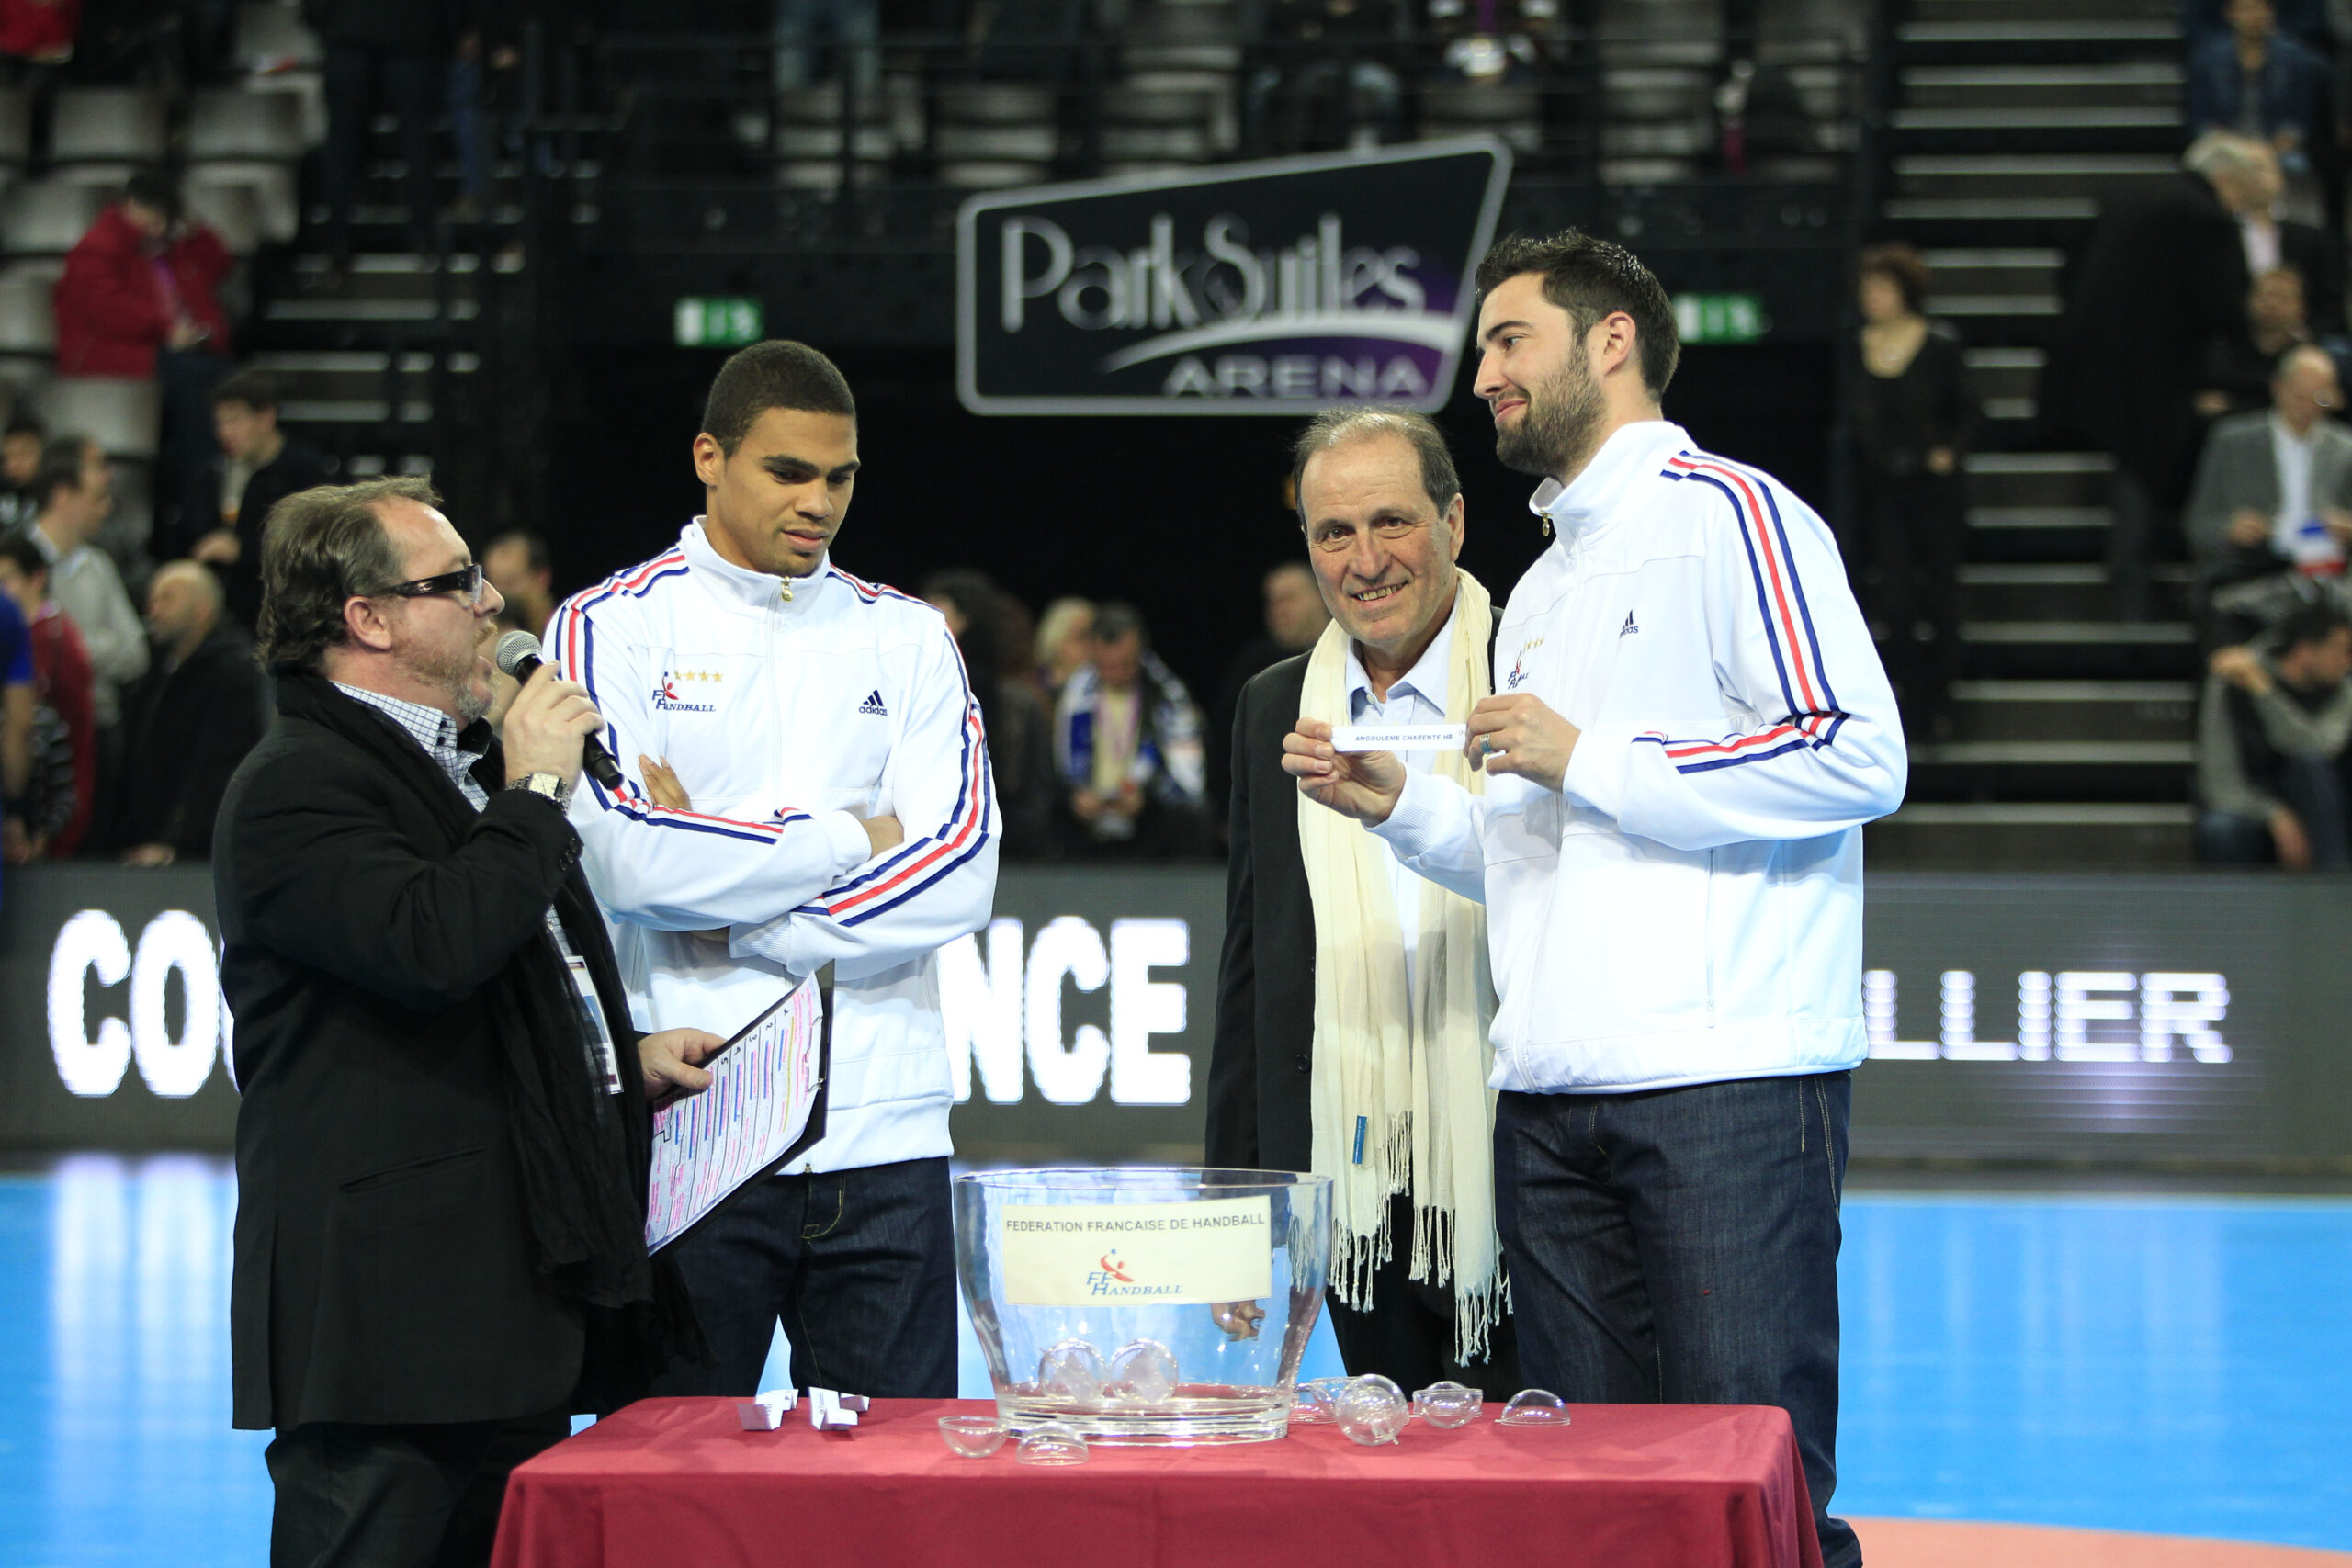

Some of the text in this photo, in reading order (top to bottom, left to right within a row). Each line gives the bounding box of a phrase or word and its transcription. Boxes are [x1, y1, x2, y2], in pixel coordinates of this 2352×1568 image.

[1163, 355, 1430, 400] ARENA
[858, 704, 888, 716] adidas
[48, 908, 241, 1098] CO
[1864, 970, 2233, 1063] LLIER
[1006, 1220, 1083, 1232] FEDERATION
[1170, 1219, 1189, 1230] DE
[1193, 1213, 1265, 1227] HANDBALL
